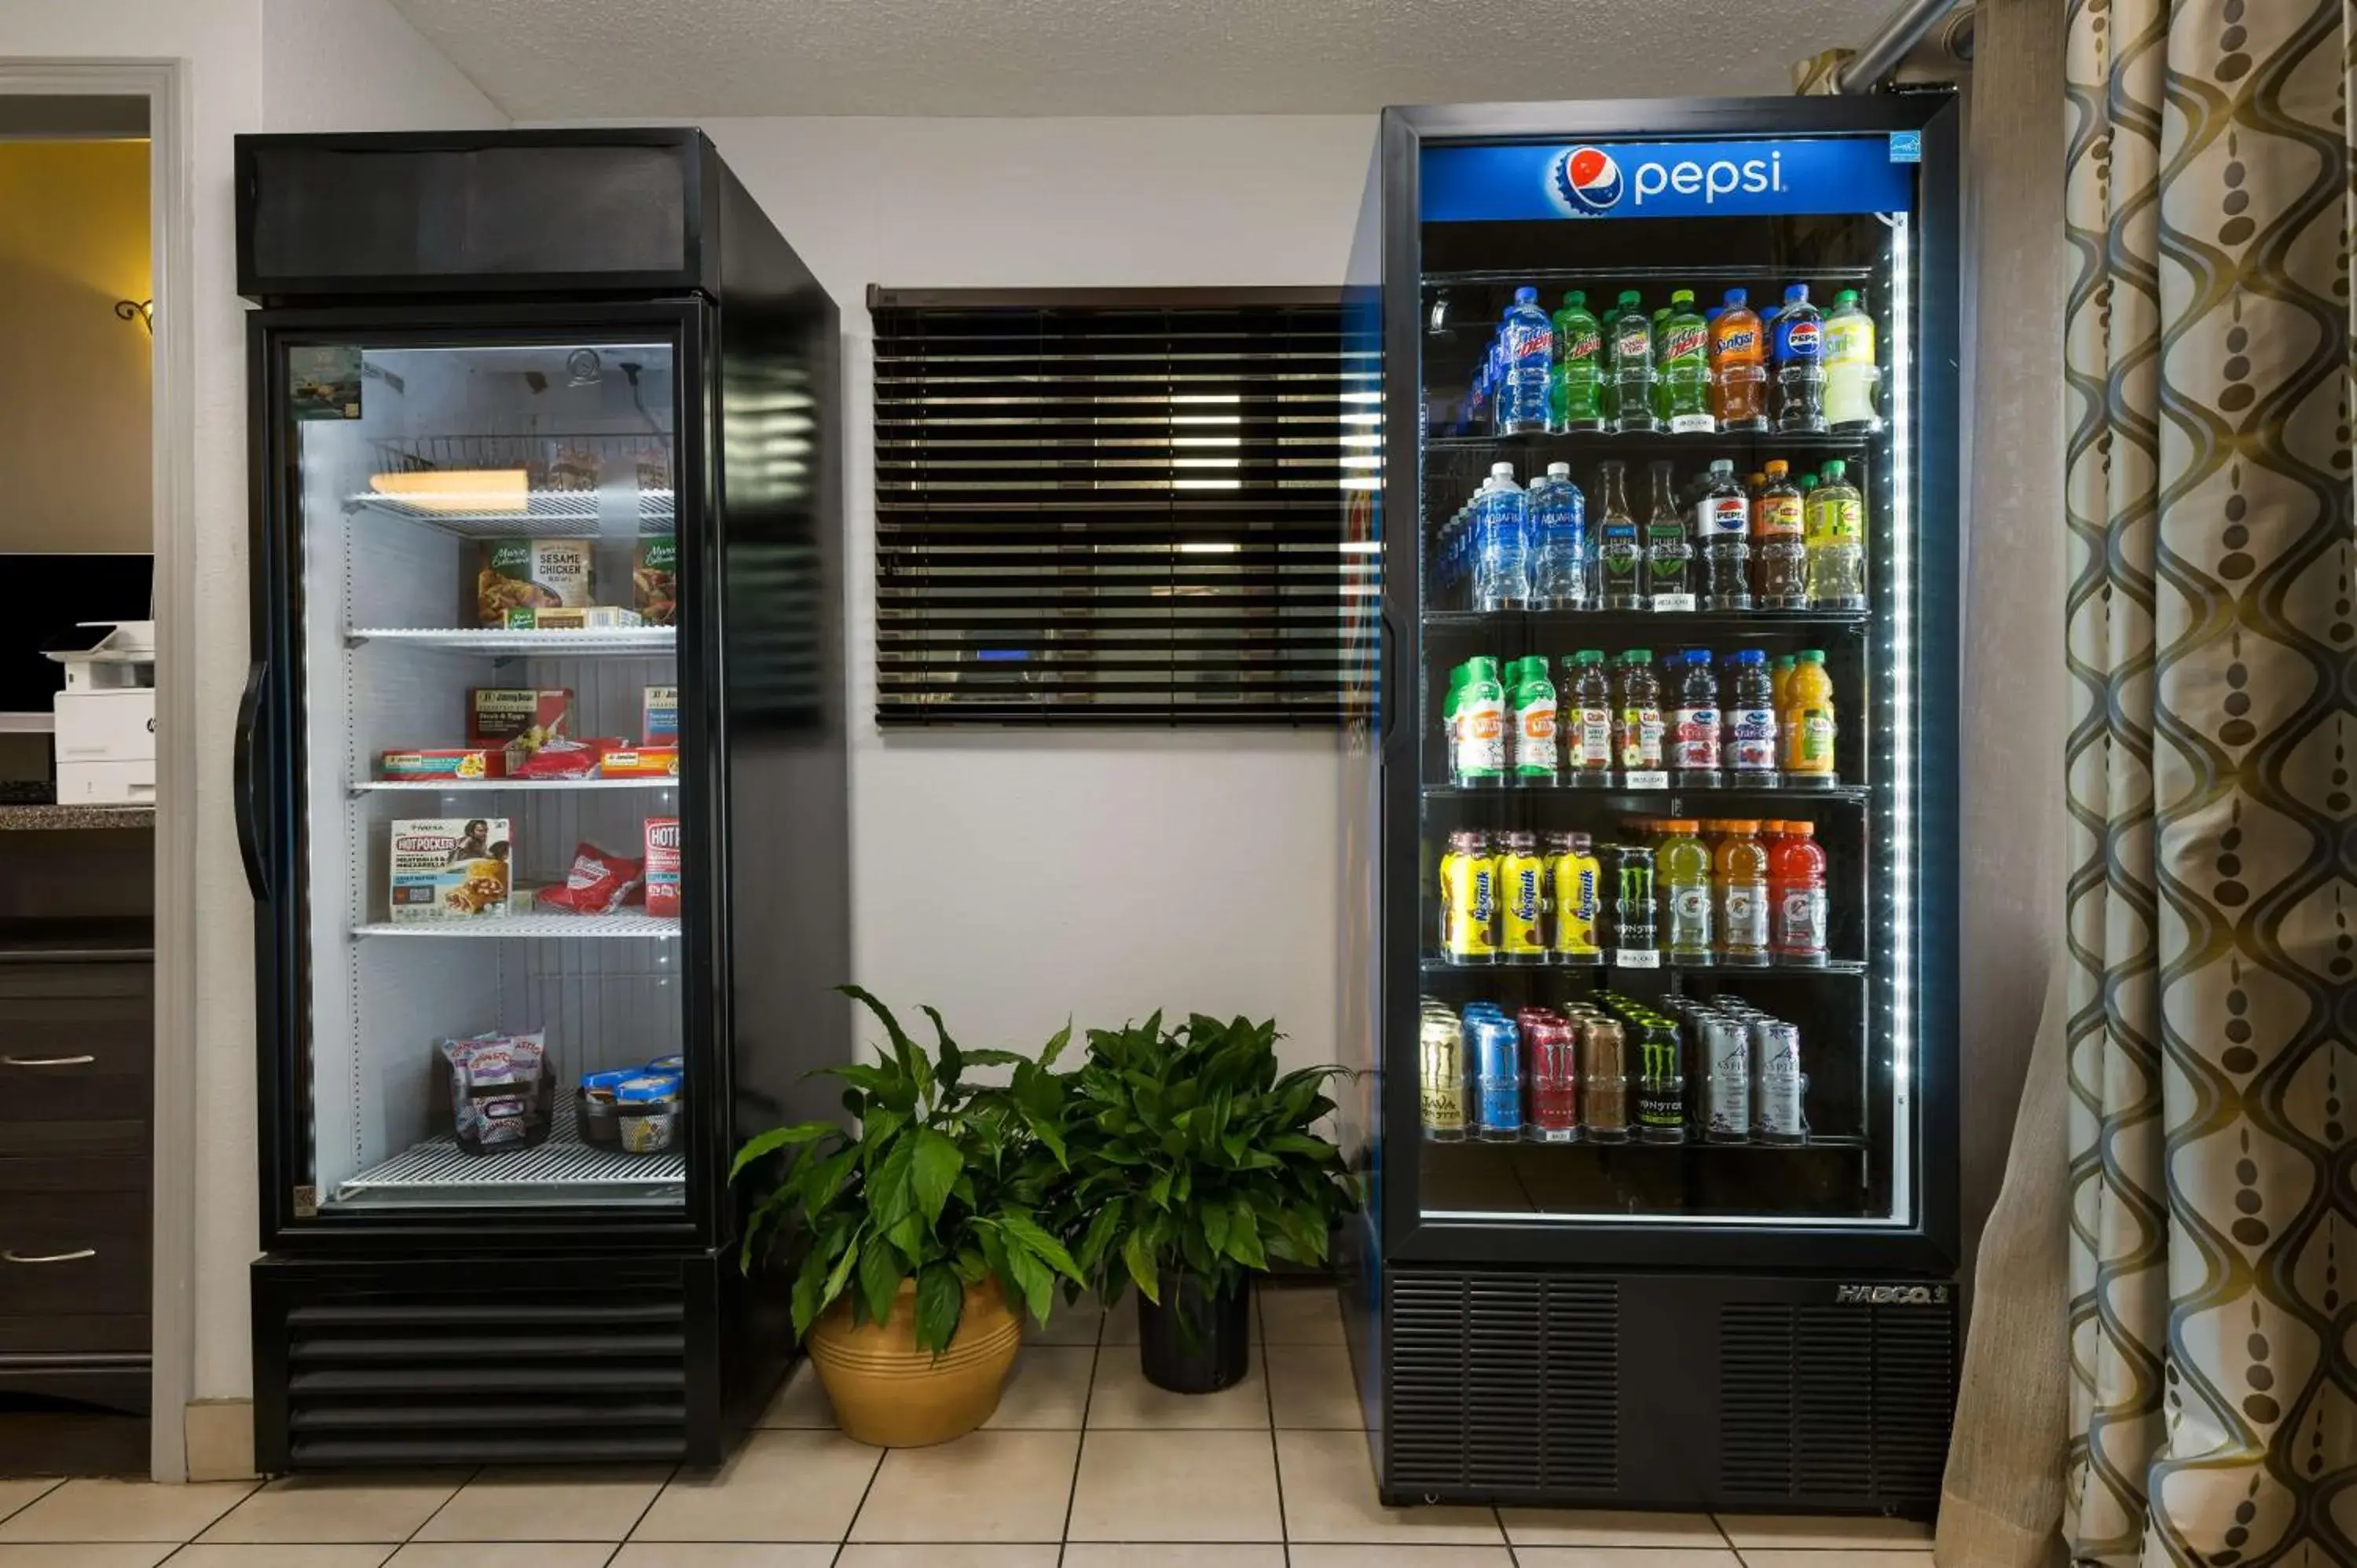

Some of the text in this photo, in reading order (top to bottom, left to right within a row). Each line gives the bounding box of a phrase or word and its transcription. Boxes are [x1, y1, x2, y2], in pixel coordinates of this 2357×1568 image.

[1635, 150, 1780, 205] pepsi
[540, 554, 580, 565] SESAME
[540, 565, 581, 574] CHICKEN
[651, 826, 675, 848] HOT
[1520, 870, 1535, 921] Nesquik
[1578, 870, 1593, 921] Nesquik
